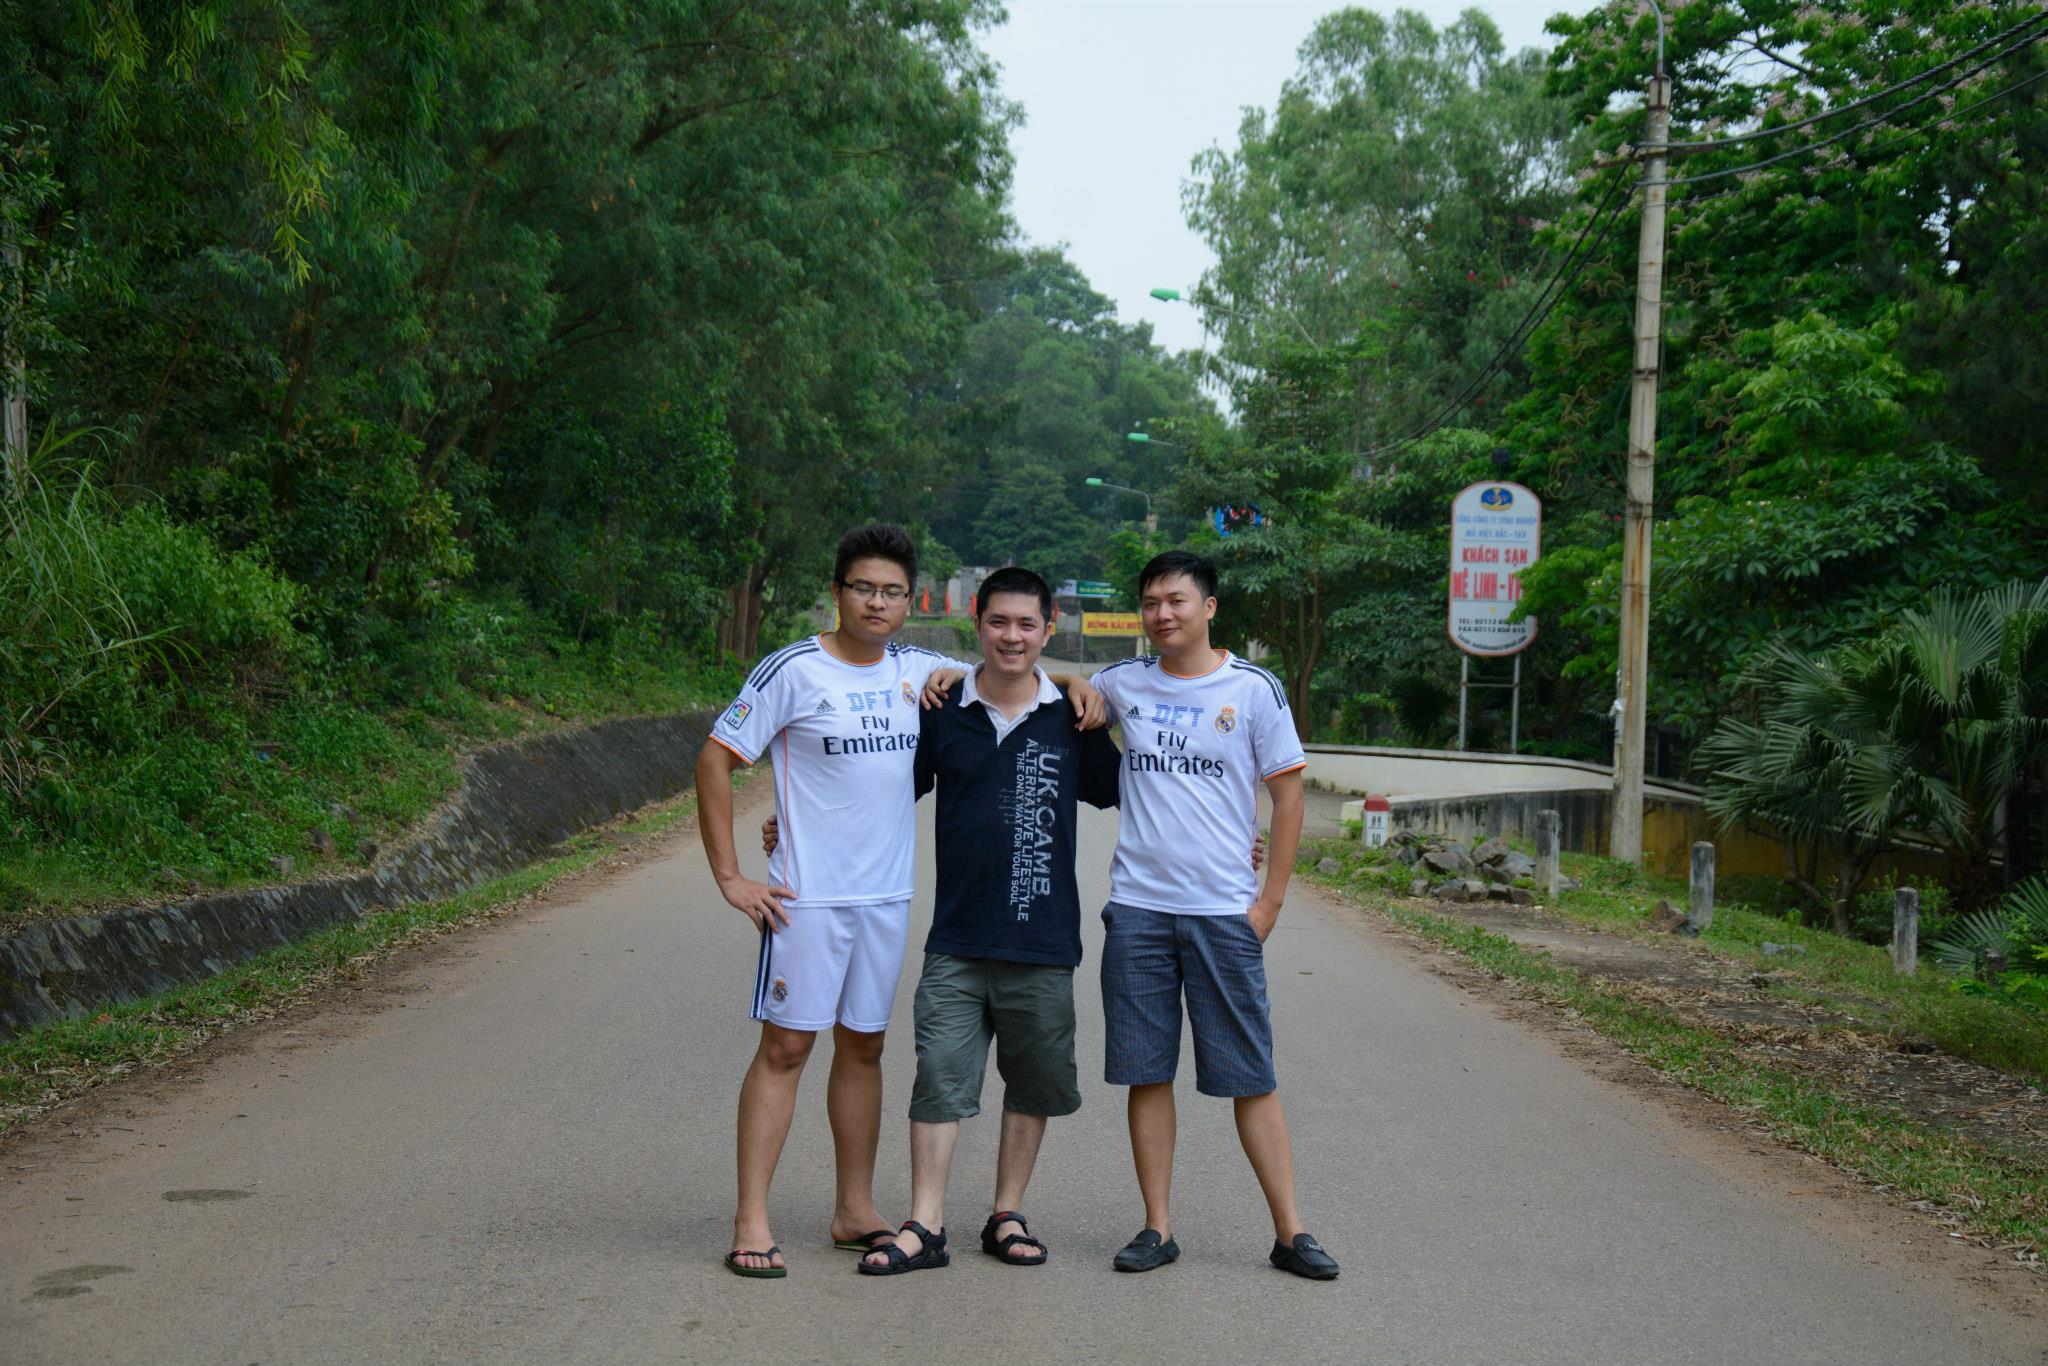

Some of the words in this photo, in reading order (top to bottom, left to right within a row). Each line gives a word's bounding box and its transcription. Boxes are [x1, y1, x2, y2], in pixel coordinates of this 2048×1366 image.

[1462, 544, 1499, 563] KHÁCH
[1504, 548, 1528, 567] SẠN
[1473, 571, 1497, 599] LINH
[847, 690, 893, 712] DFT
[861, 715, 890, 731] Fly
[1152, 704, 1204, 727] DFT
[1158, 731, 1187, 750] Fly
[1016, 752, 1025, 771] THE
[1129, 749, 1223, 778] Emirates
[1016, 774, 1025, 799] ONLY
[1023, 738, 1039, 841] ALTERNATIVE
[1014, 802, 1024, 825] WAY
[1013, 827, 1023, 848] FOR
[1012, 851, 1021, 877] YOUR
[1010, 880, 1019, 905] SOUL
[1017, 845, 1032, 921] LIFESTYLE
